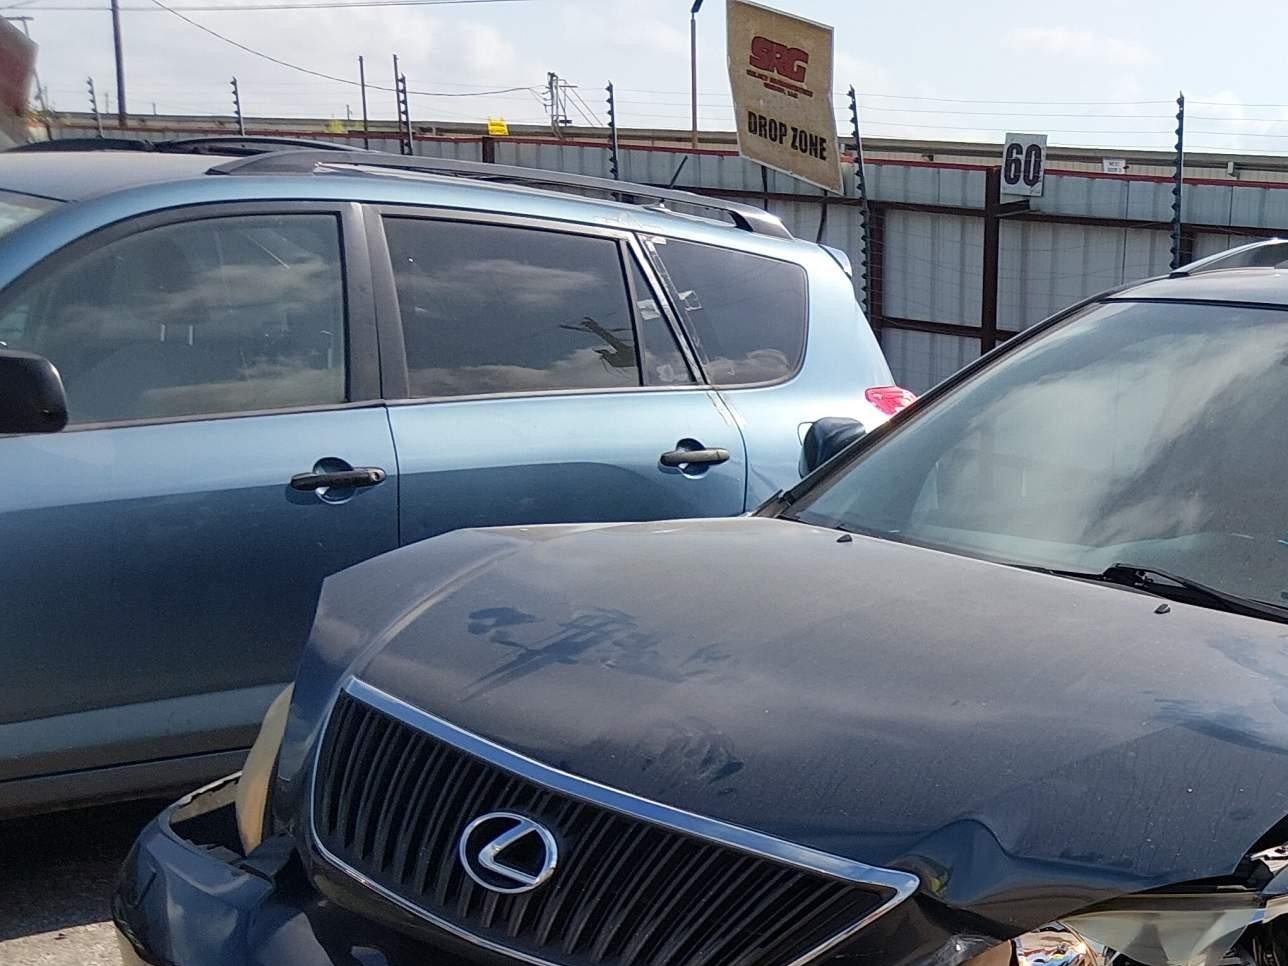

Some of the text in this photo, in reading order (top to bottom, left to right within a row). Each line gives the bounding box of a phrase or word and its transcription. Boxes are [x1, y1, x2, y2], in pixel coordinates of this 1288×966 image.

[749, 36, 809, 83] SRG
[748, 111, 827, 161] DROP ZONE
[1004, 143, 1042, 187] 60
